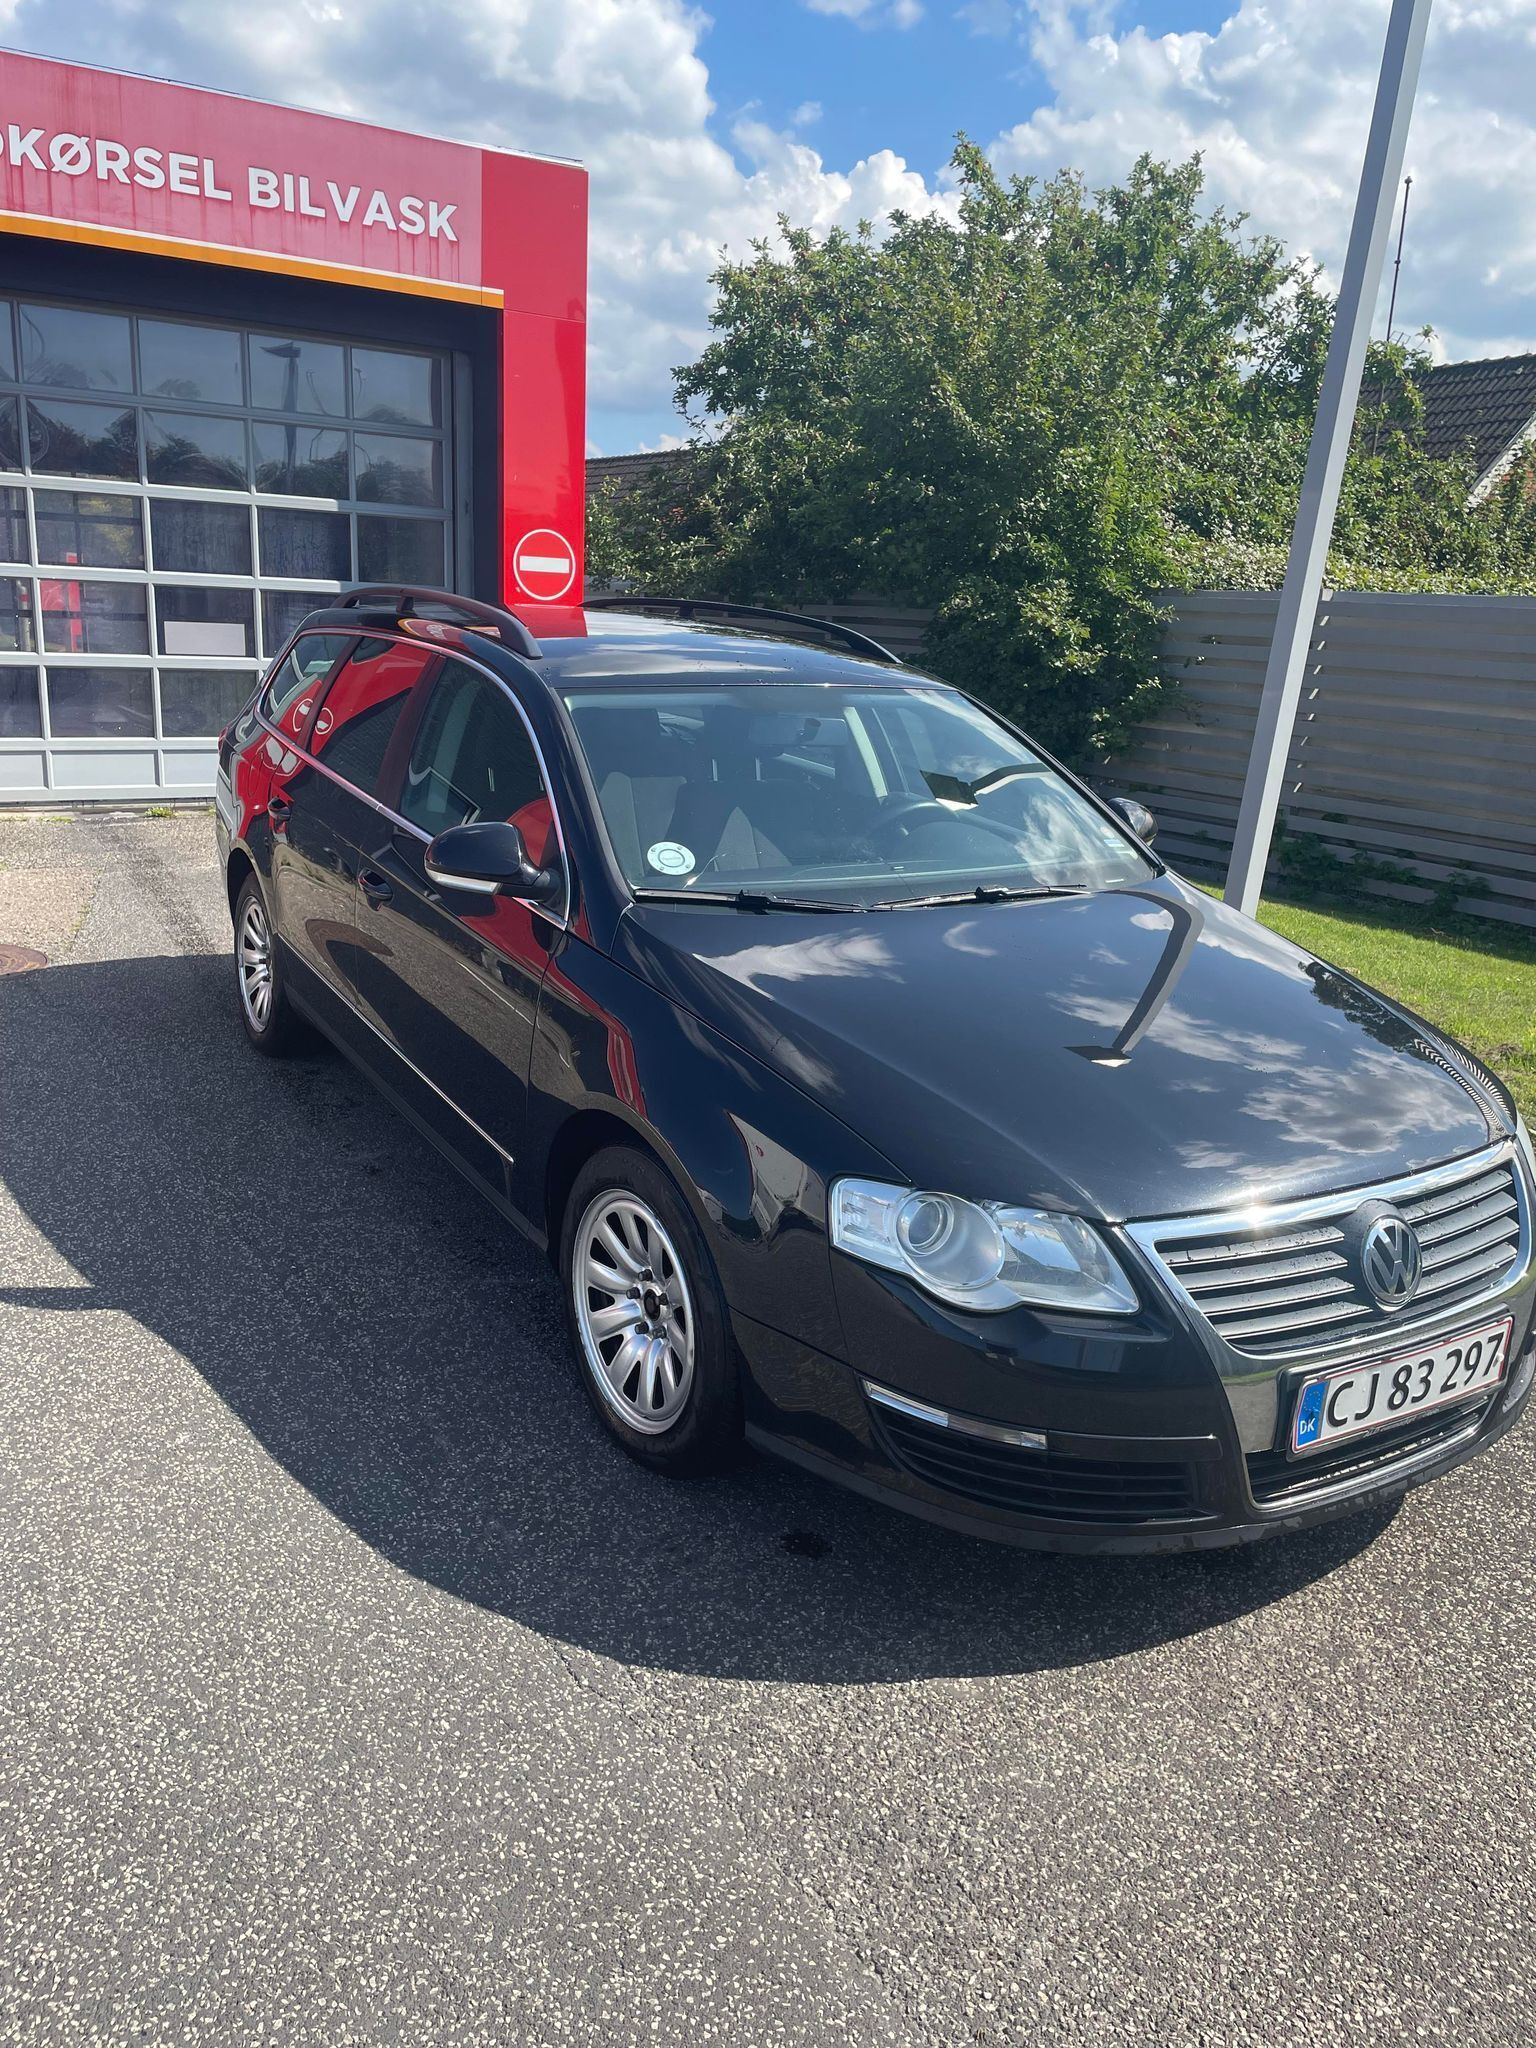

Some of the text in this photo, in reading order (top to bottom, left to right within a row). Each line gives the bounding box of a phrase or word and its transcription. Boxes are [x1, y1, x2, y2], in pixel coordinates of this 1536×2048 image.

[0, 123, 458, 242] KØRSEL BILVASK
[1363, 1217, 1420, 1302] VW
[1327, 1373, 1380, 1427] CJ
[1387, 1358, 1434, 1410] 83
[1439, 1332, 1504, 1393] 297
[1300, 1417, 1315, 1434] DK
